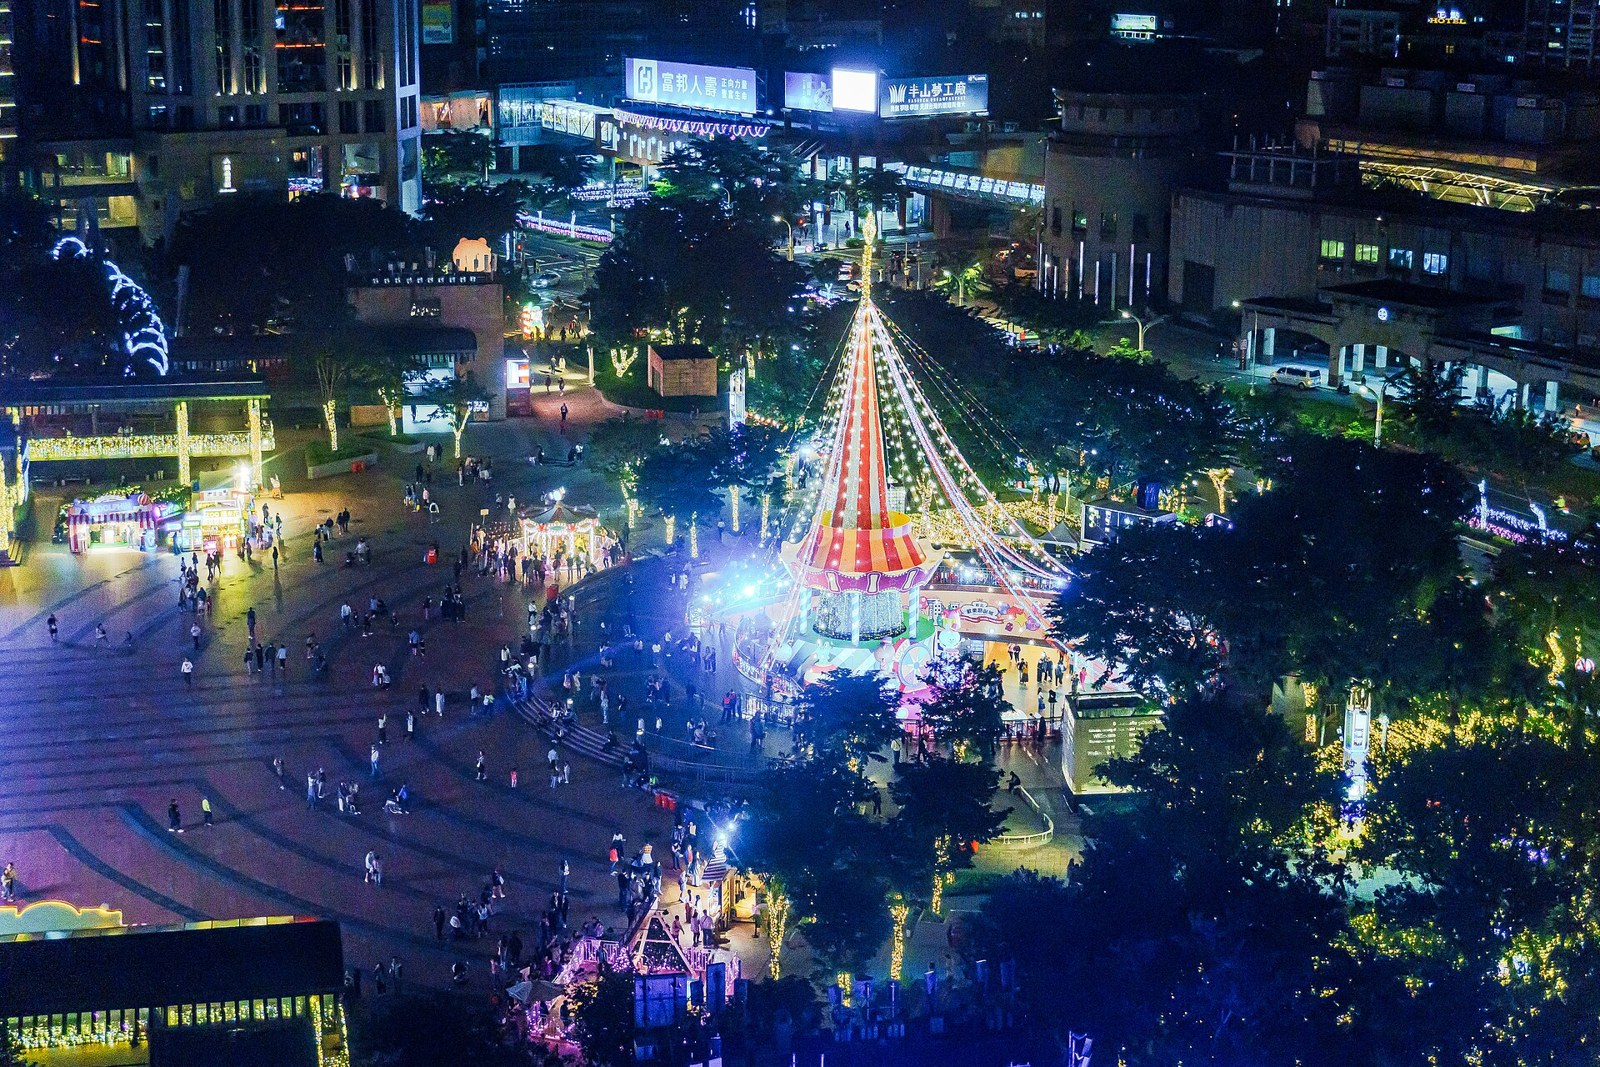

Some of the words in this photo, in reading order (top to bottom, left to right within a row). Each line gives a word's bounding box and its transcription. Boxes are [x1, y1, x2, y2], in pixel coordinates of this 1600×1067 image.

[661, 72, 718, 97] 富邦人壽
[908, 81, 967, 98] 半山夢工廠
